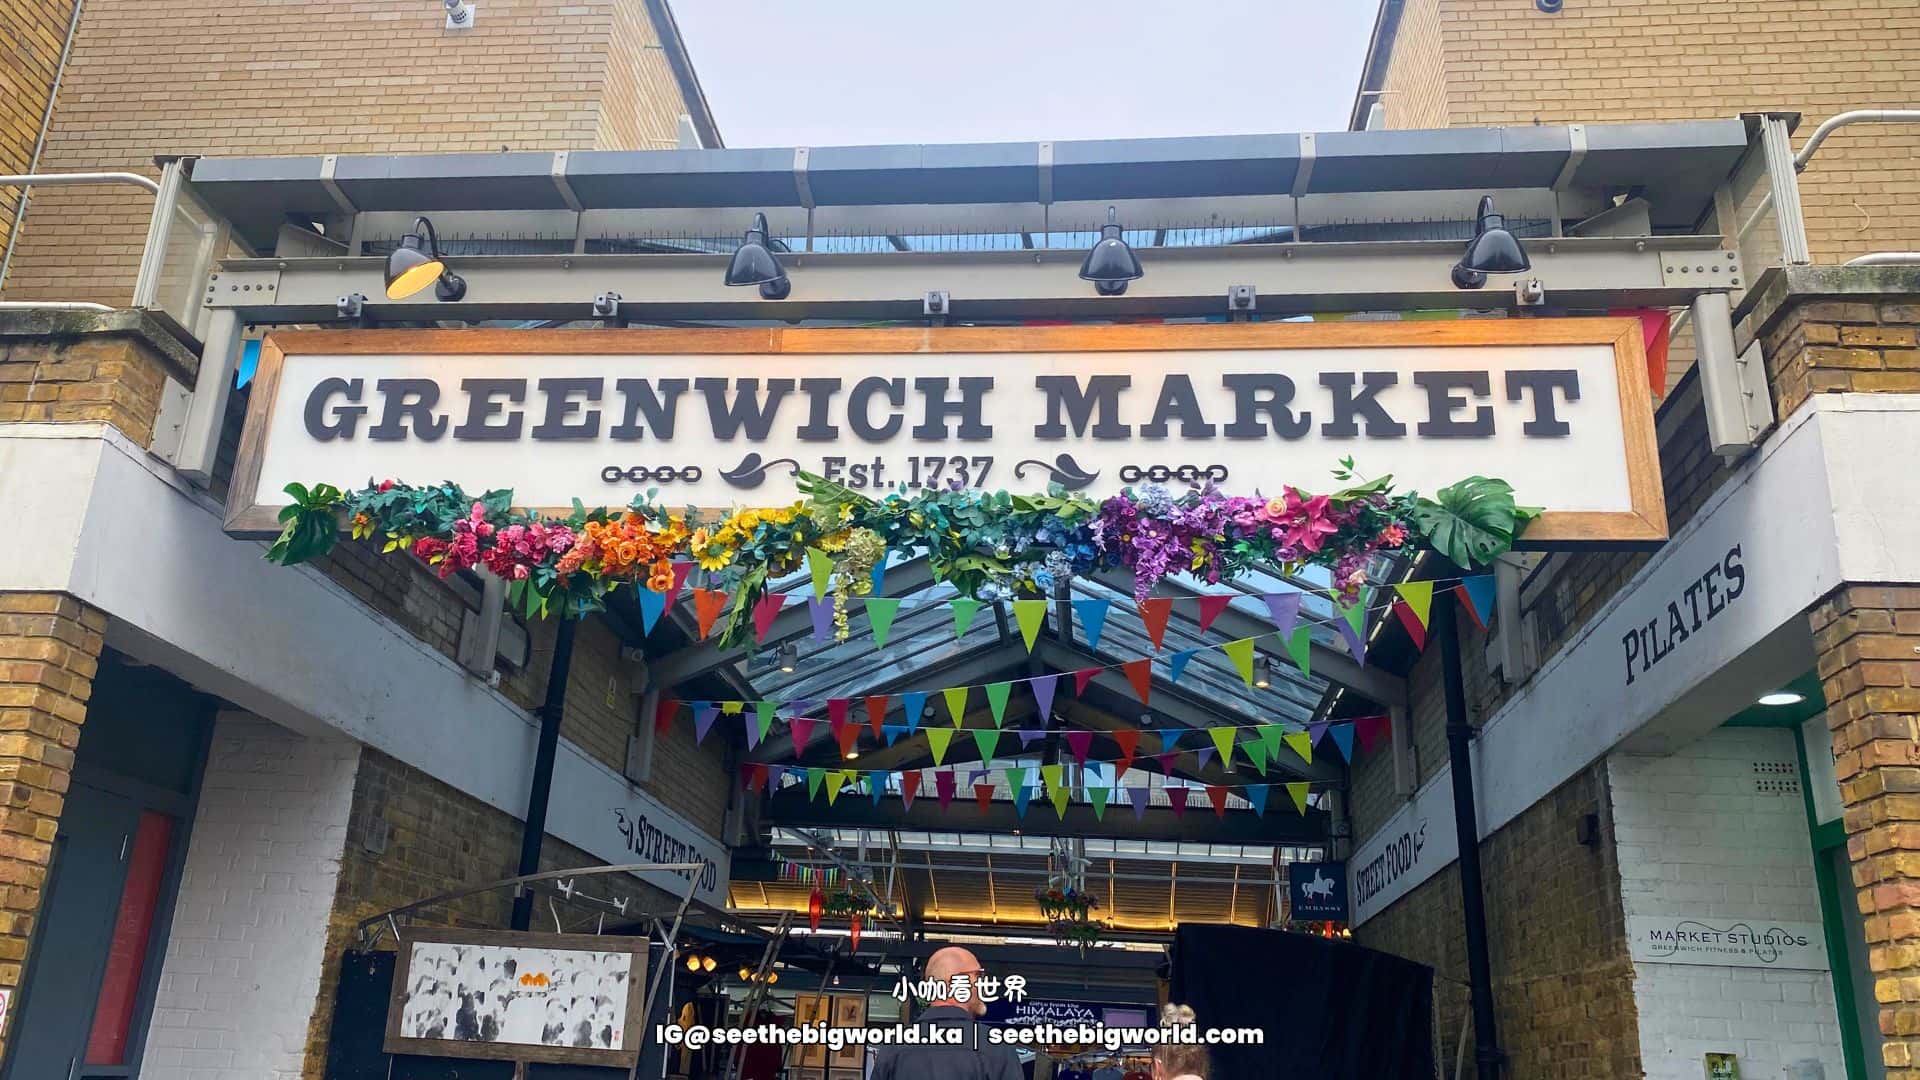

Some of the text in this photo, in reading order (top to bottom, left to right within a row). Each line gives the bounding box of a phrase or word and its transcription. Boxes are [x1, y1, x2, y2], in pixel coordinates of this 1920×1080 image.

[303, 369, 1580, 441] GREENWICH MARKET
[822, 455, 994, 490] Est. 1737
[1622, 543, 1746, 686] PILATES
[635, 814, 687, 877] STREET
[1356, 832, 1412, 907] STREET FOOD
[1650, 930, 1808, 946] MARKET STUDIOS
[1015, 1005, 1095, 1018] HIMALAYA
